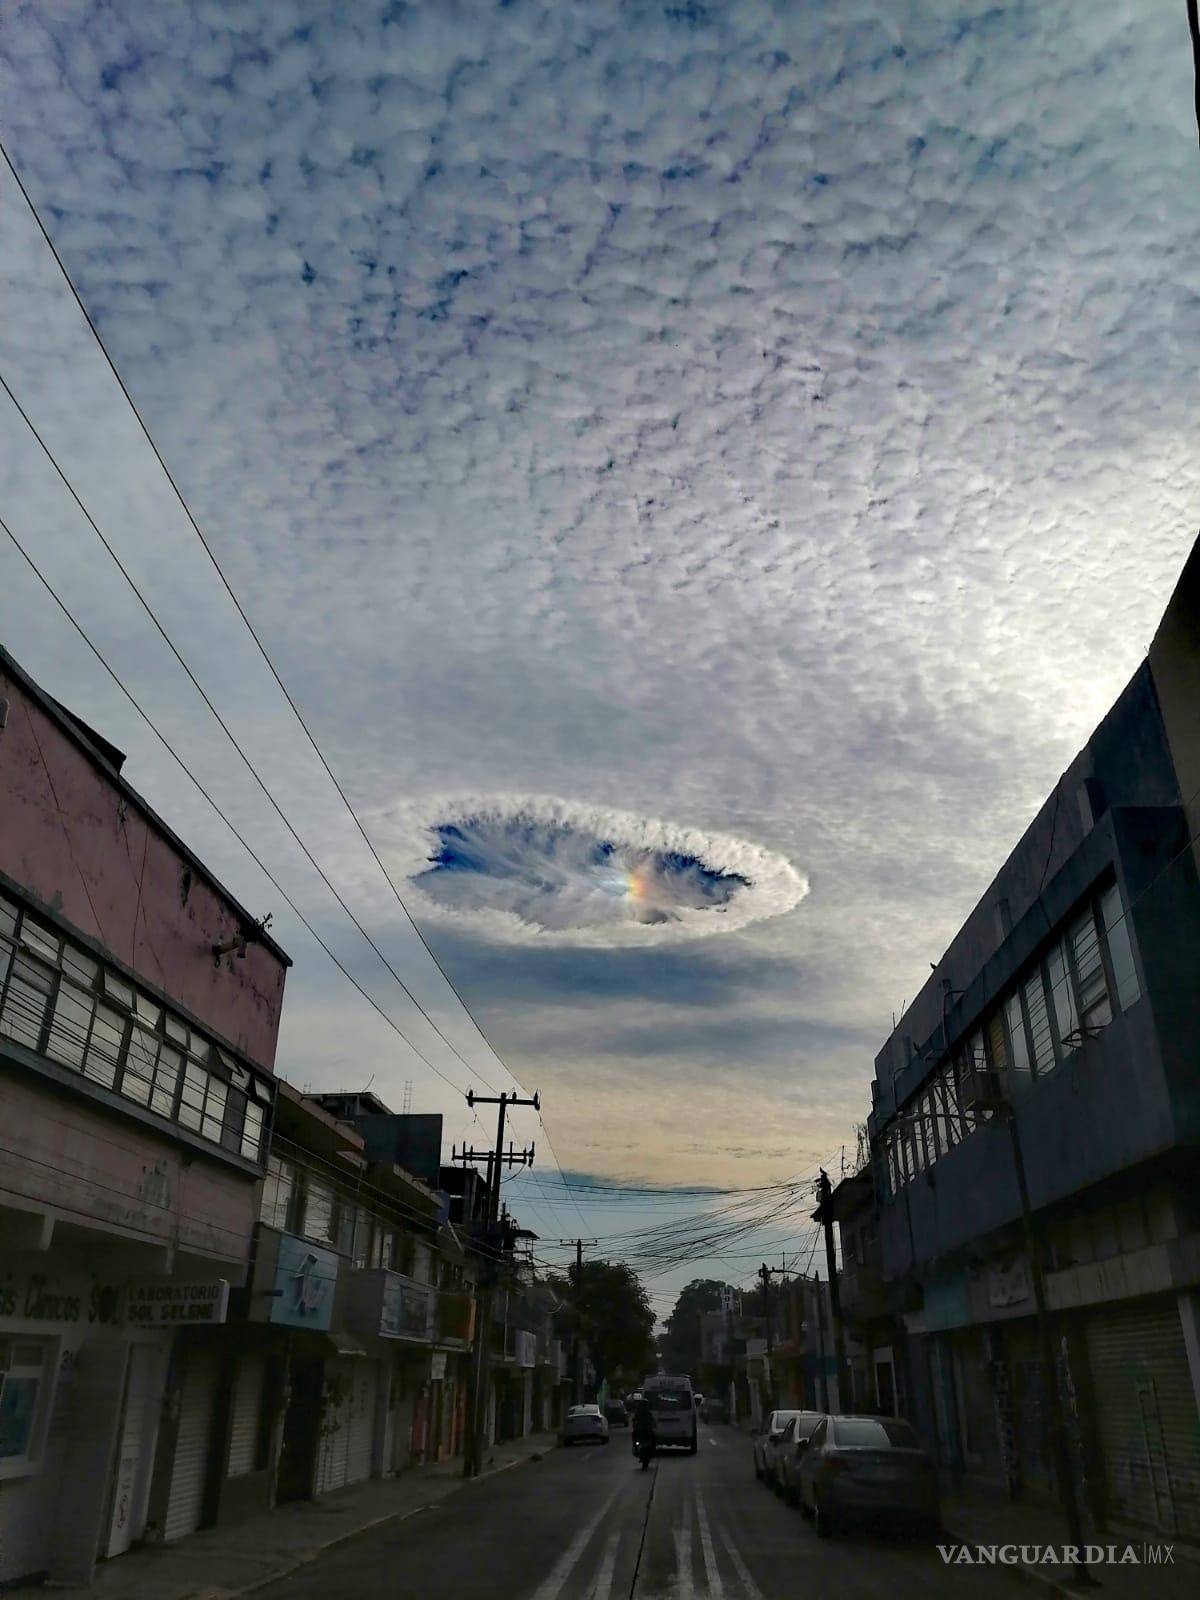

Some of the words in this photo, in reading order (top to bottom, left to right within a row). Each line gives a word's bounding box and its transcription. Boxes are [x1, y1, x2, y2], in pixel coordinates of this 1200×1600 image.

[129, 1285, 220, 1302] LABORATORIO
[128, 1304, 154, 1321] SOL
[160, 1303, 214, 1321] SELENE
